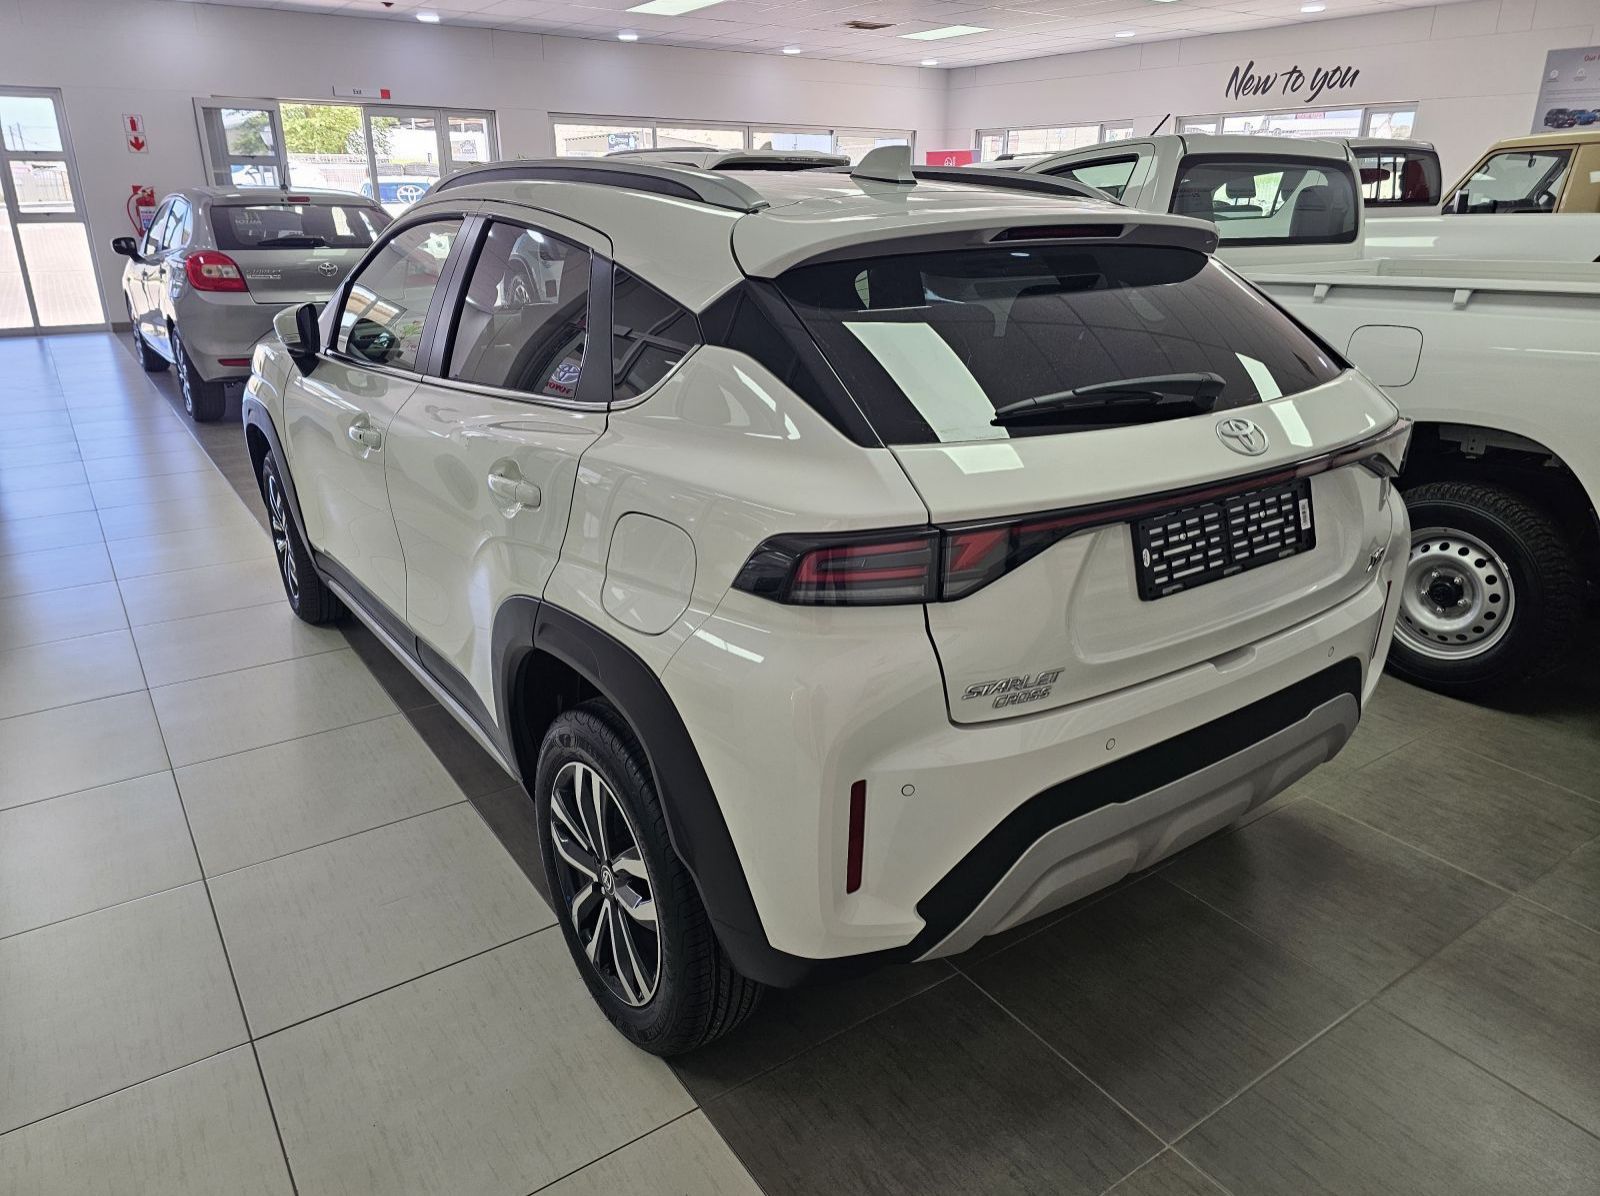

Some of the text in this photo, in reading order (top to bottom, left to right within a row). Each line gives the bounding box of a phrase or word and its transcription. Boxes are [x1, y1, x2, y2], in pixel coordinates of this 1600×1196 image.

[1226, 60, 1360, 103] New to you
[961, 667, 1065, 700] STARLET
[992, 687, 1051, 708] CROSS
